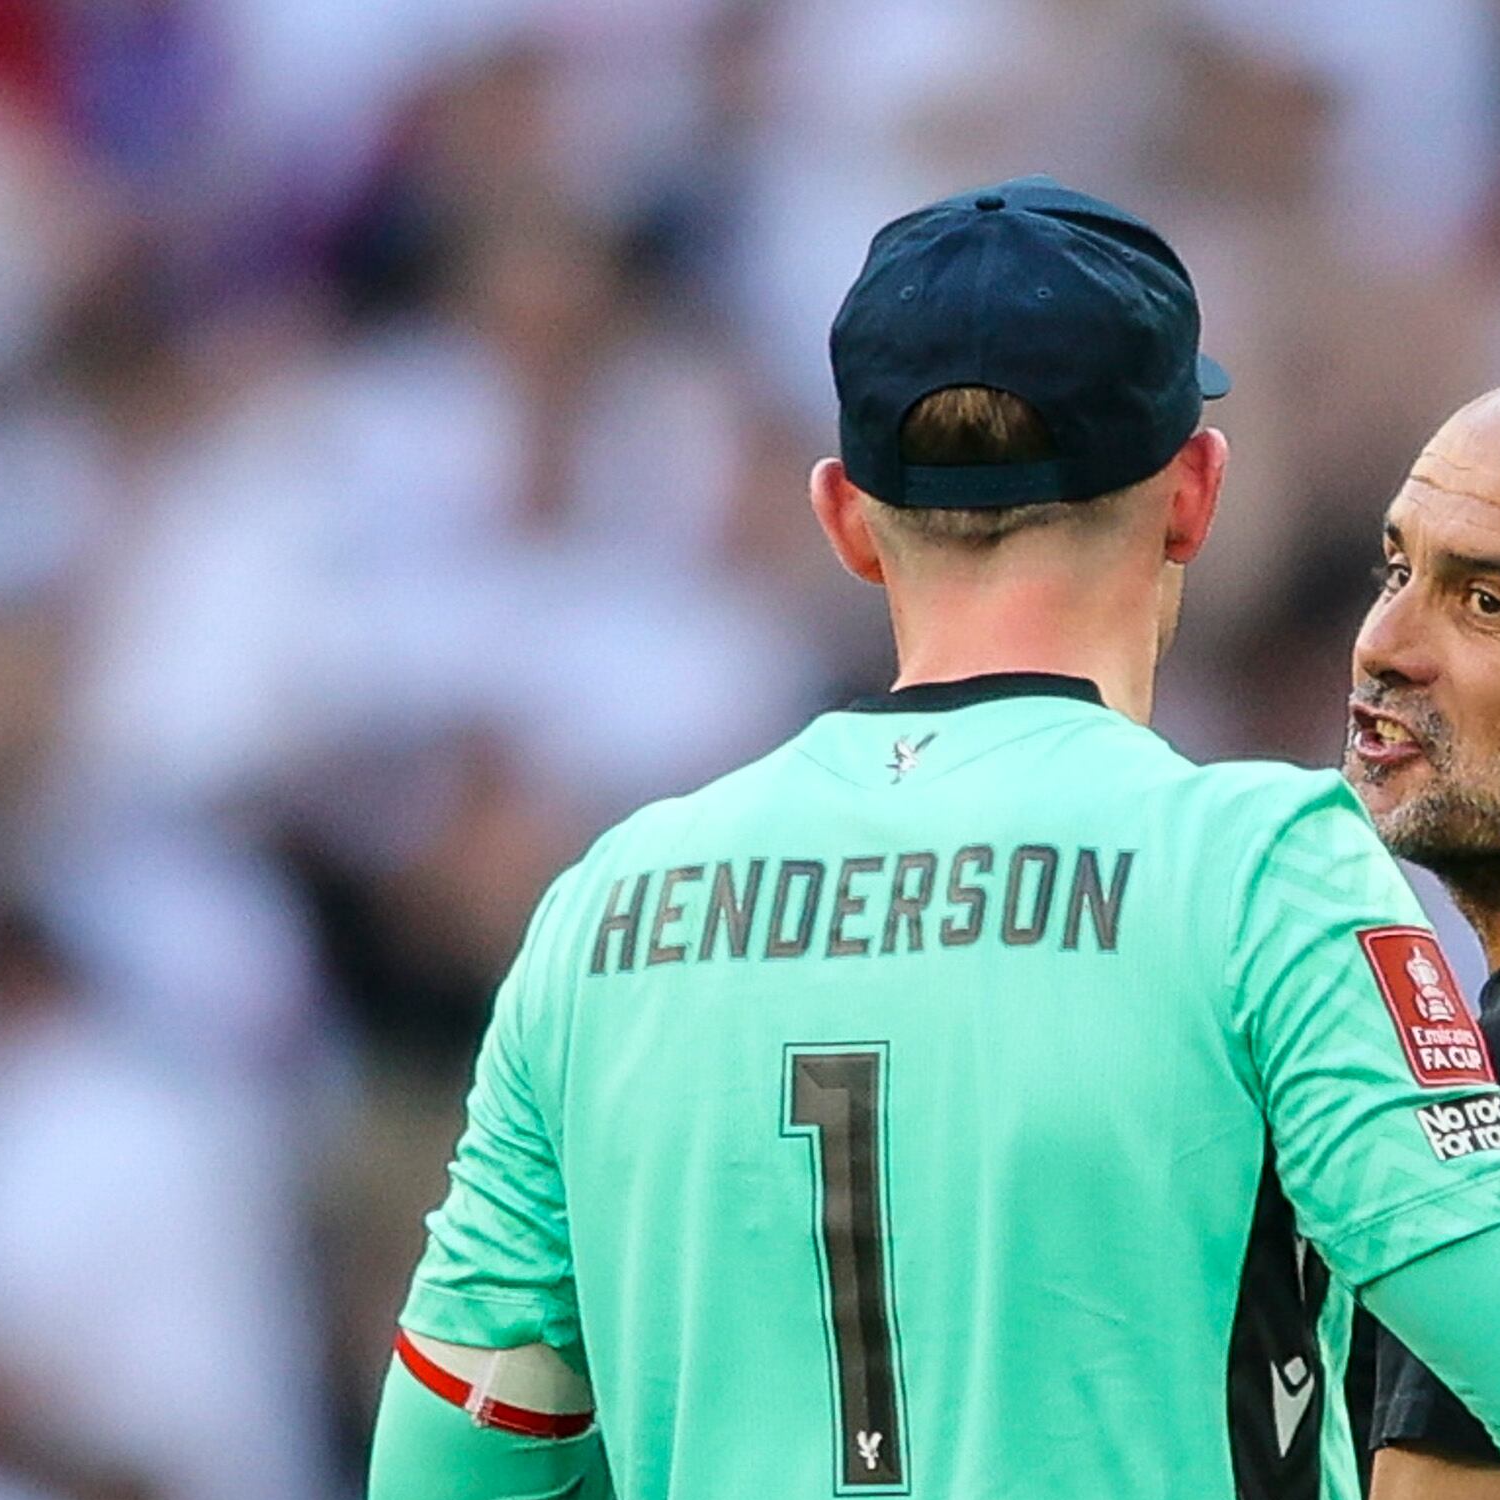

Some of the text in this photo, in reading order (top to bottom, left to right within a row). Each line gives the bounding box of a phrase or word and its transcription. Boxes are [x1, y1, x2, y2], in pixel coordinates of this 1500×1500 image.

[588, 842, 1139, 976] HENDERSON
[1419, 1045, 1483, 1071] FA CUP
[1417, 1104, 1465, 1138] No
[780, 1040, 911, 1497] 1
